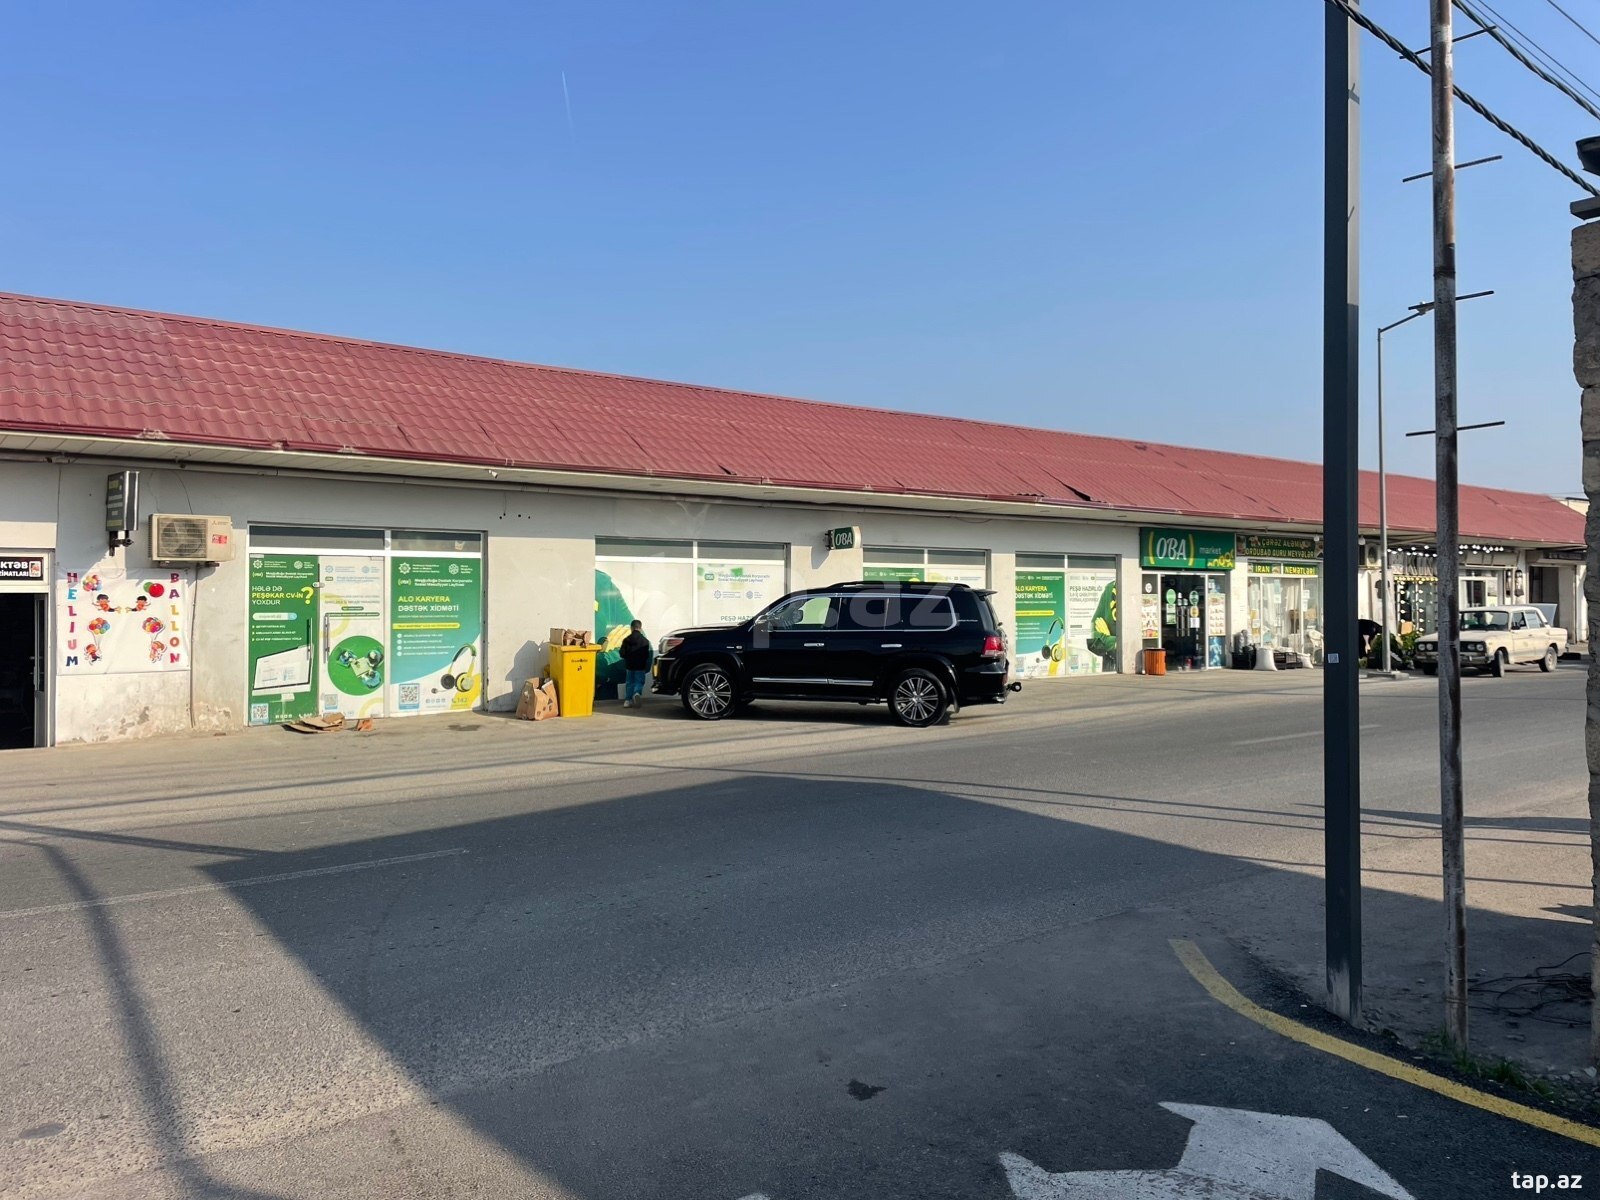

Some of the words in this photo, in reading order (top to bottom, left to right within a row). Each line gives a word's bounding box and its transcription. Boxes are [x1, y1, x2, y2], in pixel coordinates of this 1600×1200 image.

[835, 533, 853, 546] OBA
[1156, 537, 1187, 560] OBA
[1200, 547, 1222, 555] market
[66, 572, 78, 666] HELIUM
[169, 573, 180, 663] BALLON
